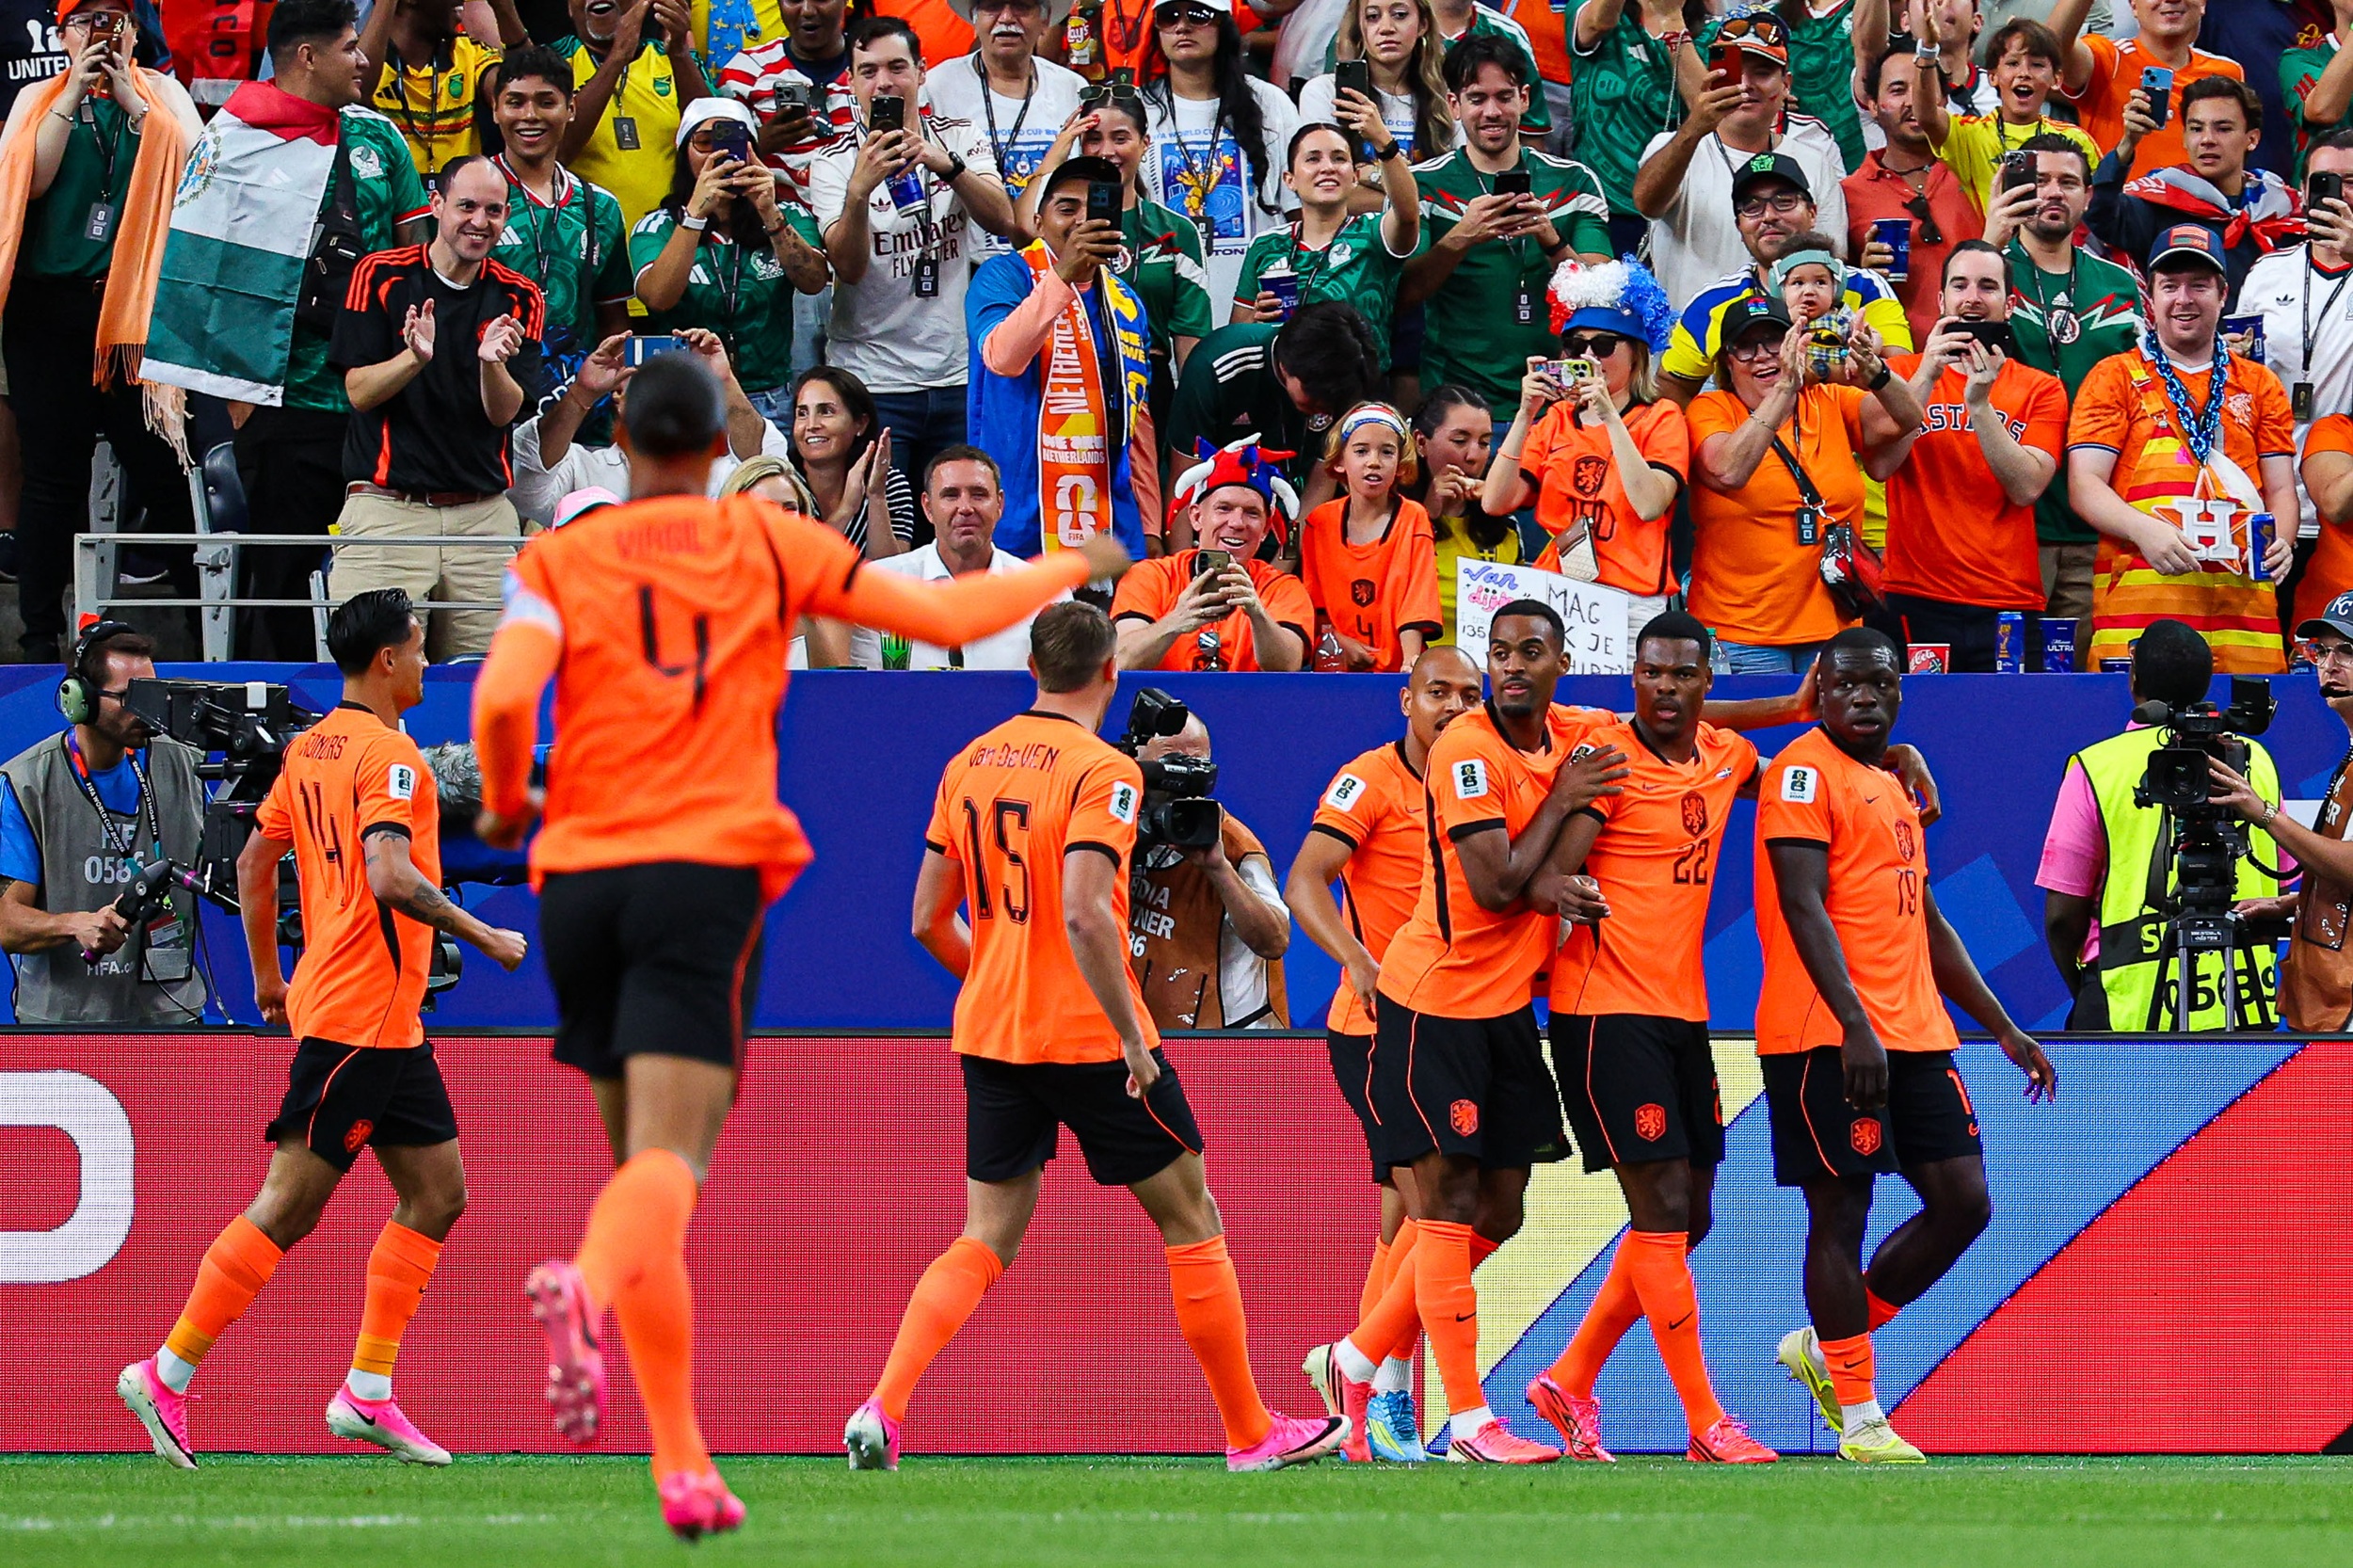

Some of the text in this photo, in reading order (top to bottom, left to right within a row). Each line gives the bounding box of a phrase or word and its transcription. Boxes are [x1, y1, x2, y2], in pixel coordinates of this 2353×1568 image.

[872, 209, 965, 256] Emiates
[1042, 448, 1106, 465] NETHERLANDS
[638, 582, 711, 723] 4
[1355, 614, 1375, 648] 4
[1587, 632, 1614, 656] JE
[86, 782, 95, 797] FIFA
[92, 795, 108, 819] WORLD
[104, 817, 114, 832] CUP
[299, 777, 346, 907] 14
[964, 796, 1032, 926] 15
[1673, 838, 1710, 886] 22
[1895, 868, 1917, 918] 19
